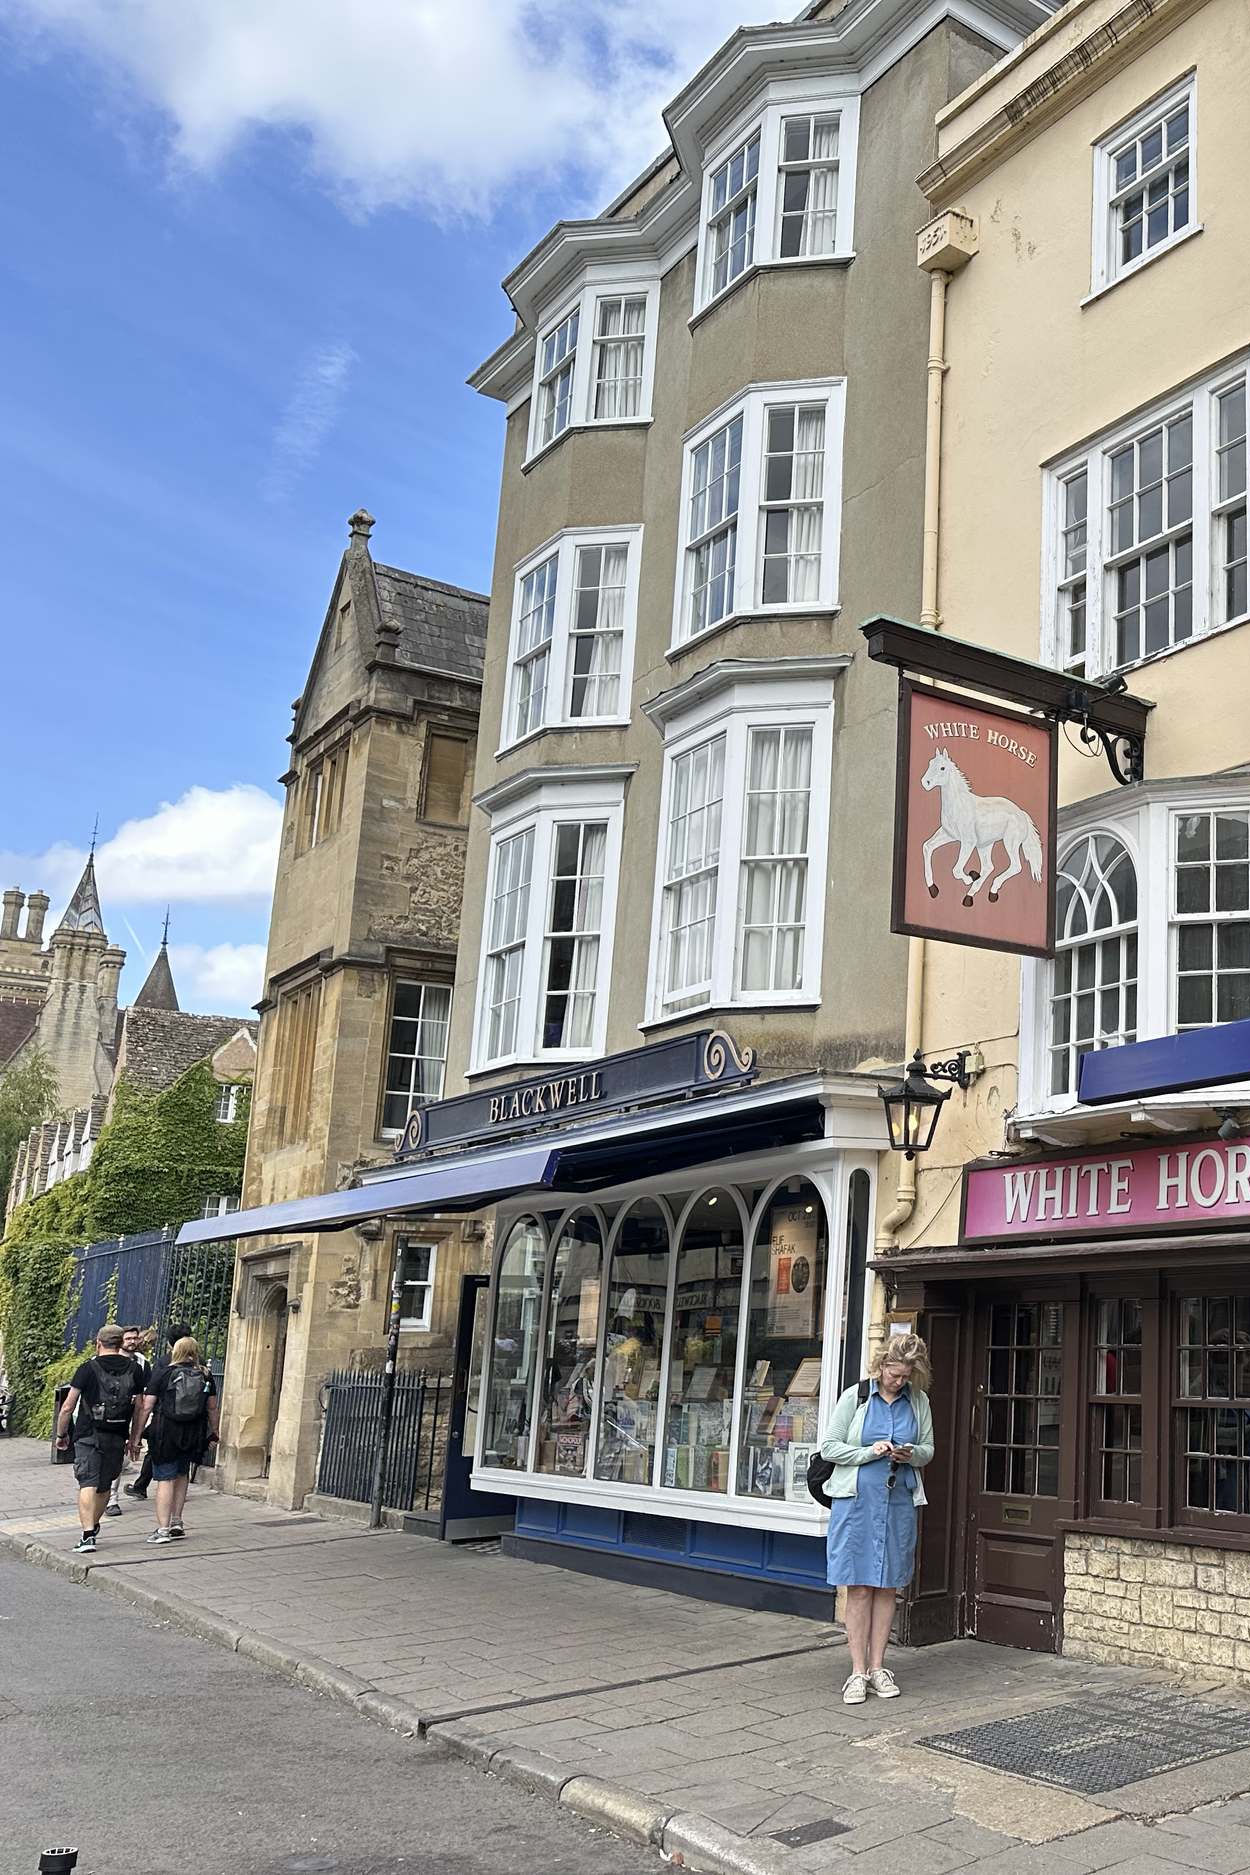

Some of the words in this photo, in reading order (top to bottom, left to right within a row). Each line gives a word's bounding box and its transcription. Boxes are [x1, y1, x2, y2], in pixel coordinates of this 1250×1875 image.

[923, 722, 980, 740] WHITE
[987, 729, 1038, 768] HORSE
[489, 1071, 601, 1123] BLACKWELL
[1003, 1159, 1134, 1224] WHITE
[772, 1243, 796, 1255] SHAFAK
